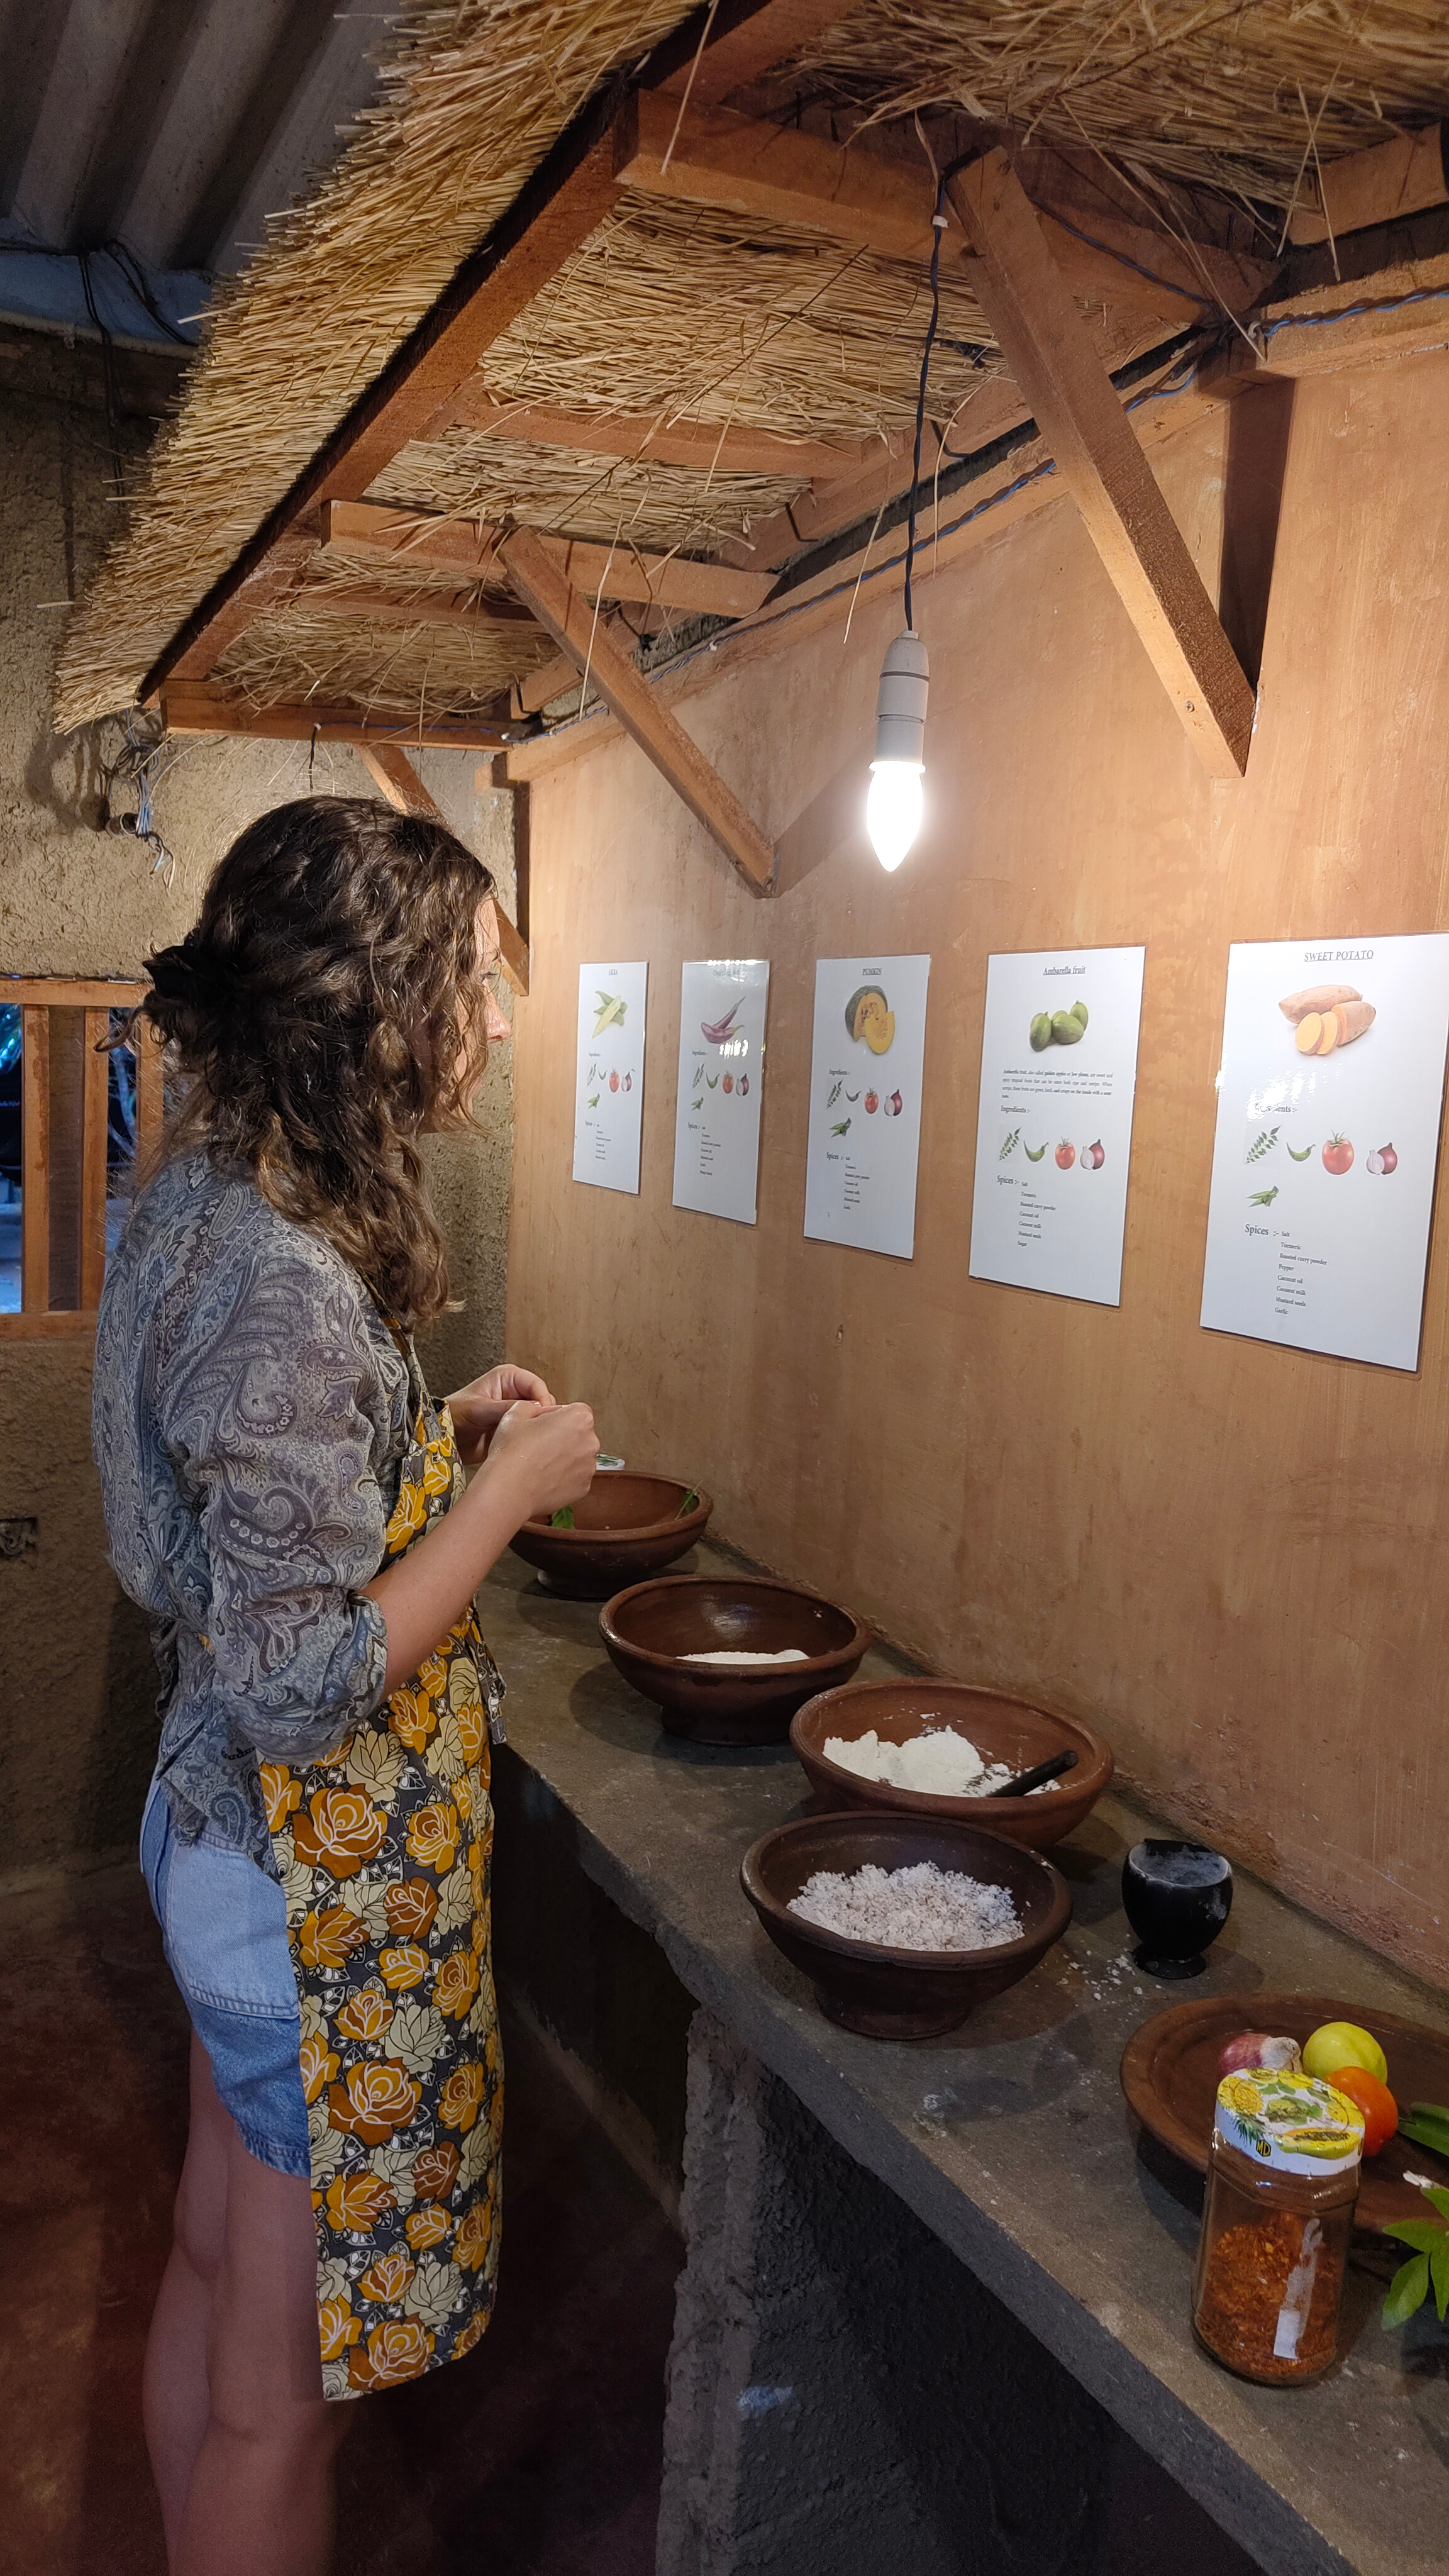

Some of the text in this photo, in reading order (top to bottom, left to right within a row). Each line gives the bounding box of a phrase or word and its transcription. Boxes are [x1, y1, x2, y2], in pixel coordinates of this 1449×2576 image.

[1304, 950, 1374, 962] SWEET POTATO
[1043, 966, 1085, 975] Ambarella fruit
[1001, 1106, 1026, 1114] Ingredients
[826, 1152, 839, 1161] Spices
[997, 1175, 1014, 1185] Spices
[1245, 1224, 1269, 1236] Spices
[1280, 1241, 1301, 1250] Turmeric
[1277, 1275, 1296, 1283] Coconut
[1277, 1285, 1295, 1294] Coconut
[1257, 2140, 1270, 2156] MD
